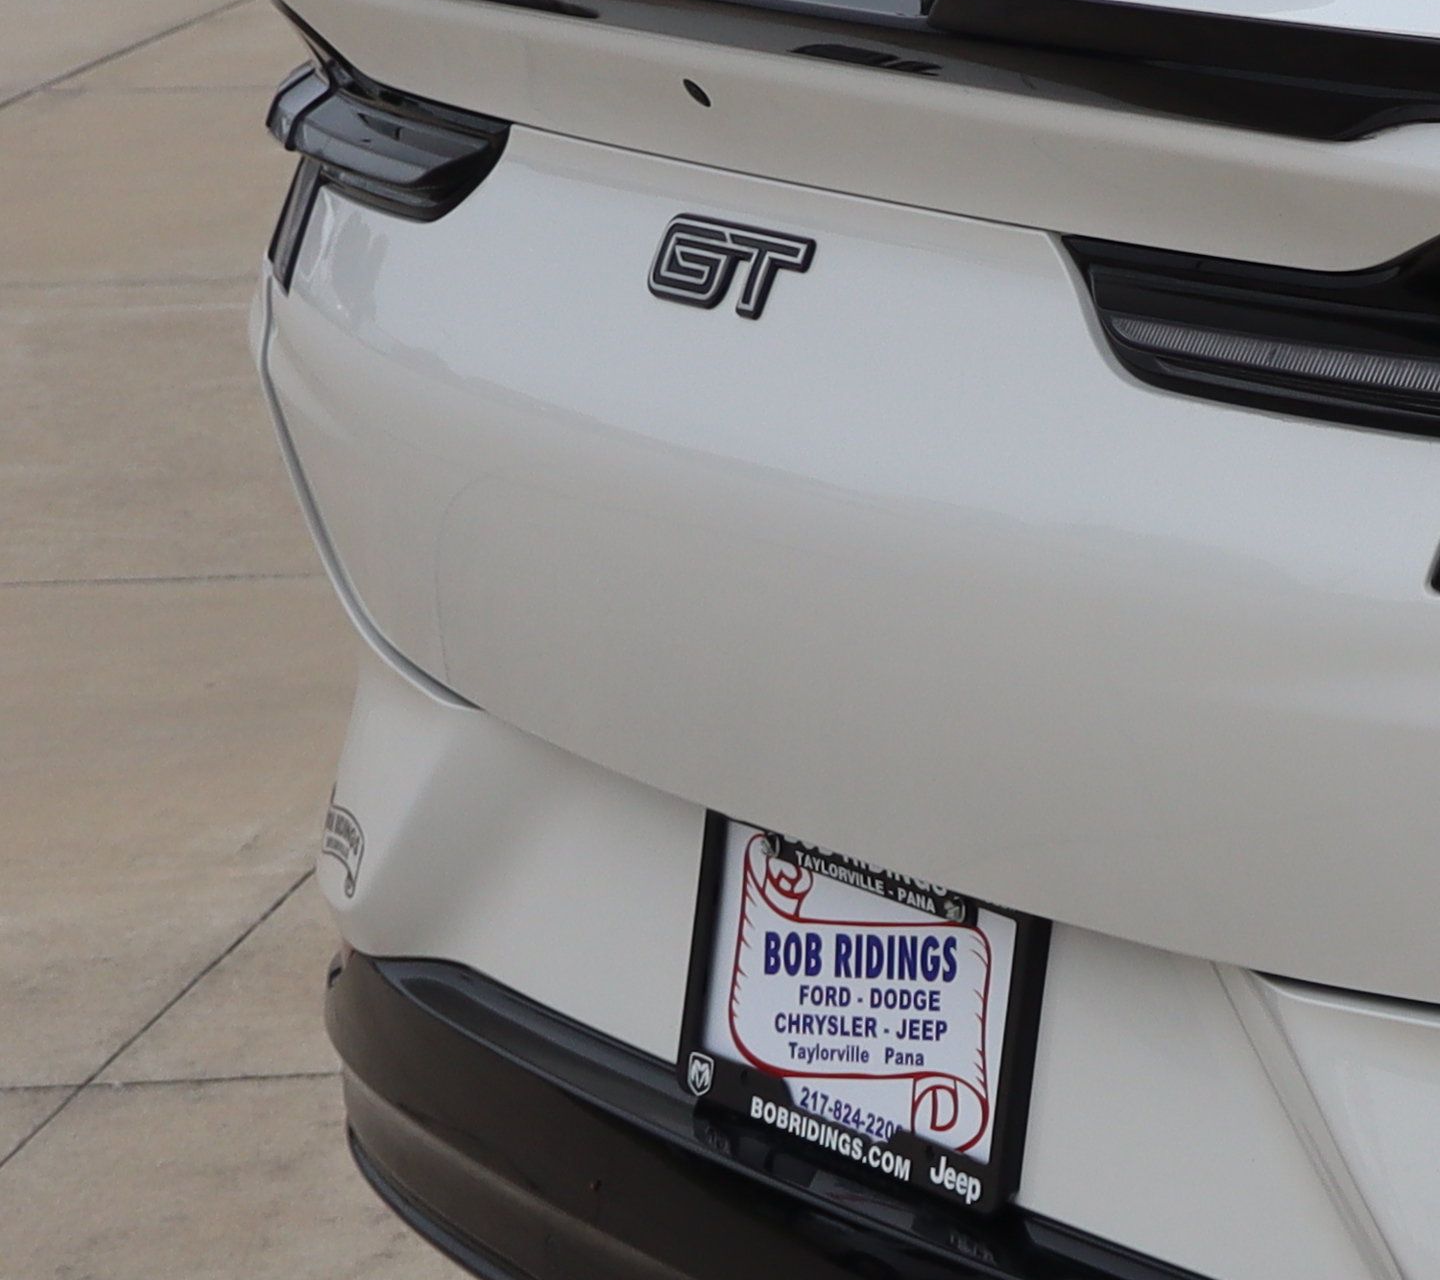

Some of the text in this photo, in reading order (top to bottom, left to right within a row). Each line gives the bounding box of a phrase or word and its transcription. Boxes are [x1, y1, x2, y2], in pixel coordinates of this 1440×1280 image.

[648, 212, 816, 320] GT
[795, 850, 885, 896] TAYLORVILLE
[897, 888, 936, 914] PANA
[764, 931, 957, 983] BOB RIDINGS
[799, 985, 851, 1007] FORD
[870, 988, 941, 1011] DODGE
[775, 1012, 878, 1038] CHRYSLER
[896, 1019, 948, 1041] JEEP
[788, 1042, 925, 1067] Taylorville Pana
[750, 1096, 911, 1181] BOBRIDINGS.COM
[930, 1155, 981, 1205] Jeep
